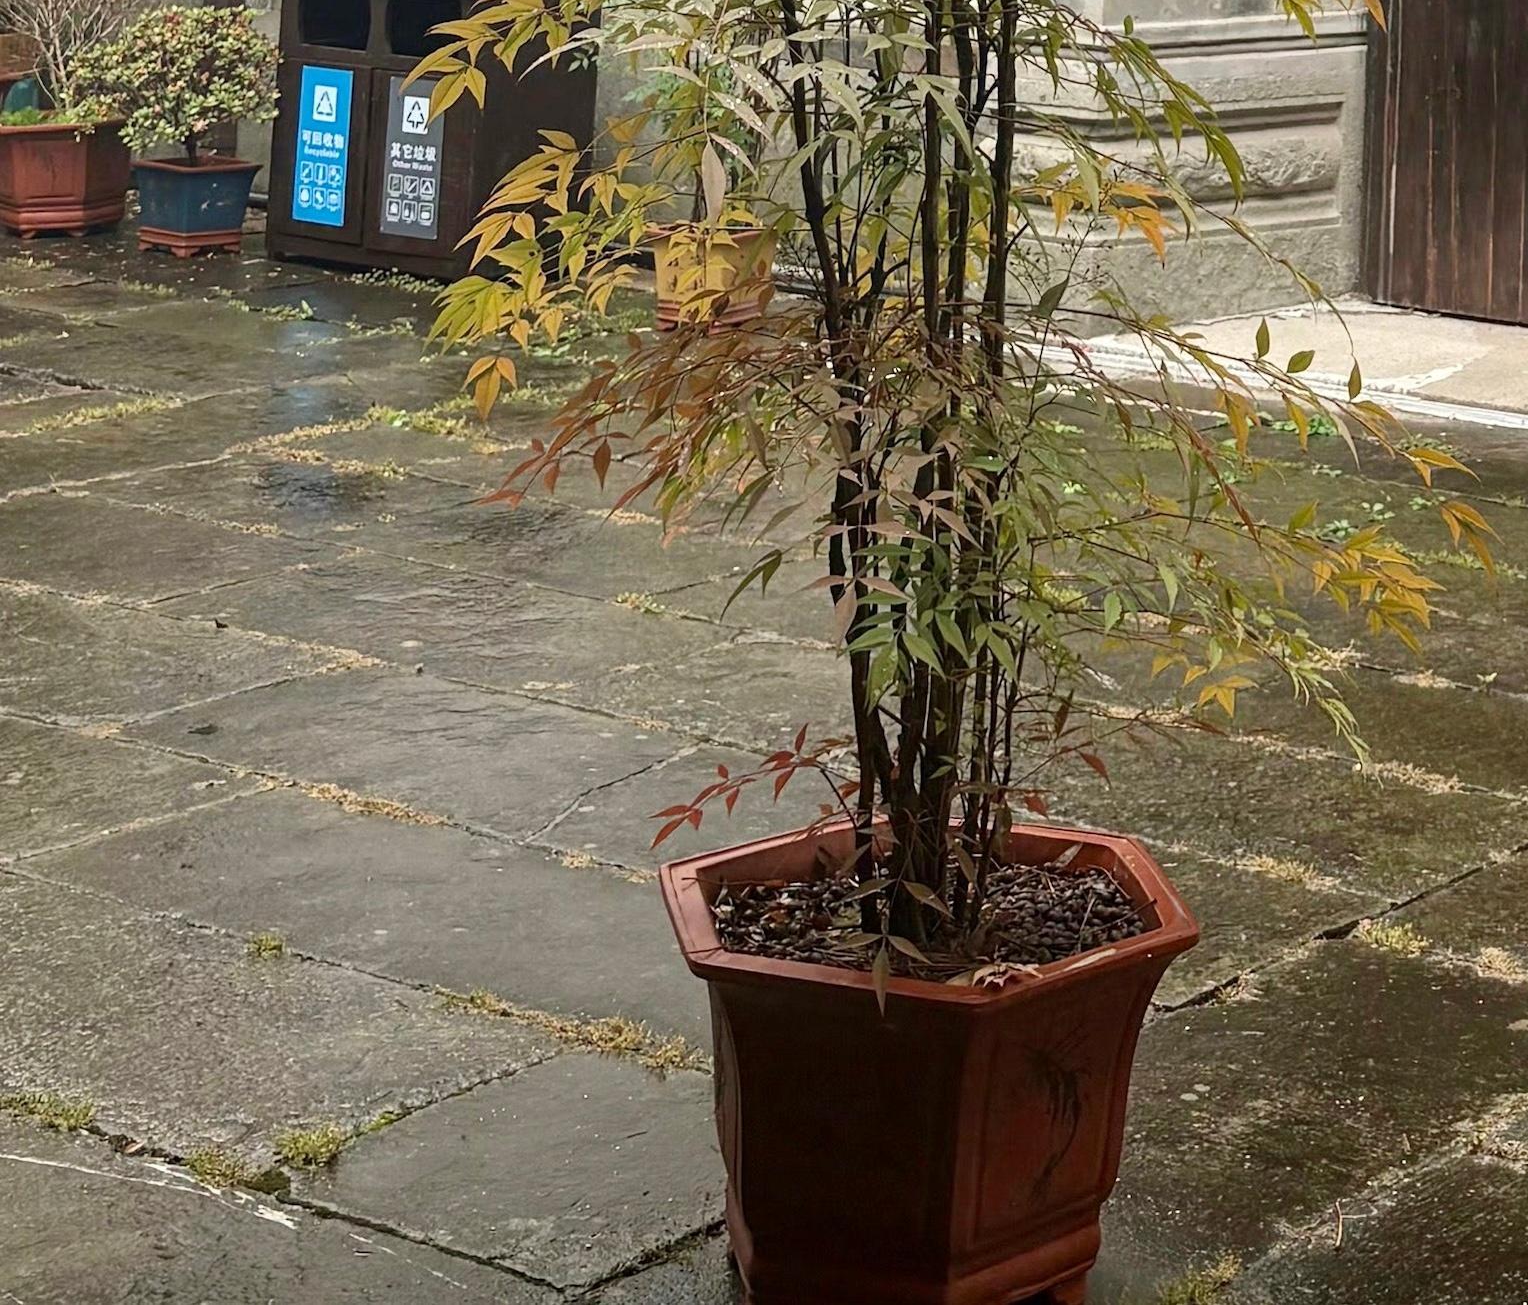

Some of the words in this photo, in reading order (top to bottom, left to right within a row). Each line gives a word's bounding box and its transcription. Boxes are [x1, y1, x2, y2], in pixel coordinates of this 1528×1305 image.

[302, 129, 345, 149] 可回收物
[390, 142, 437, 162] 其它垃圾
